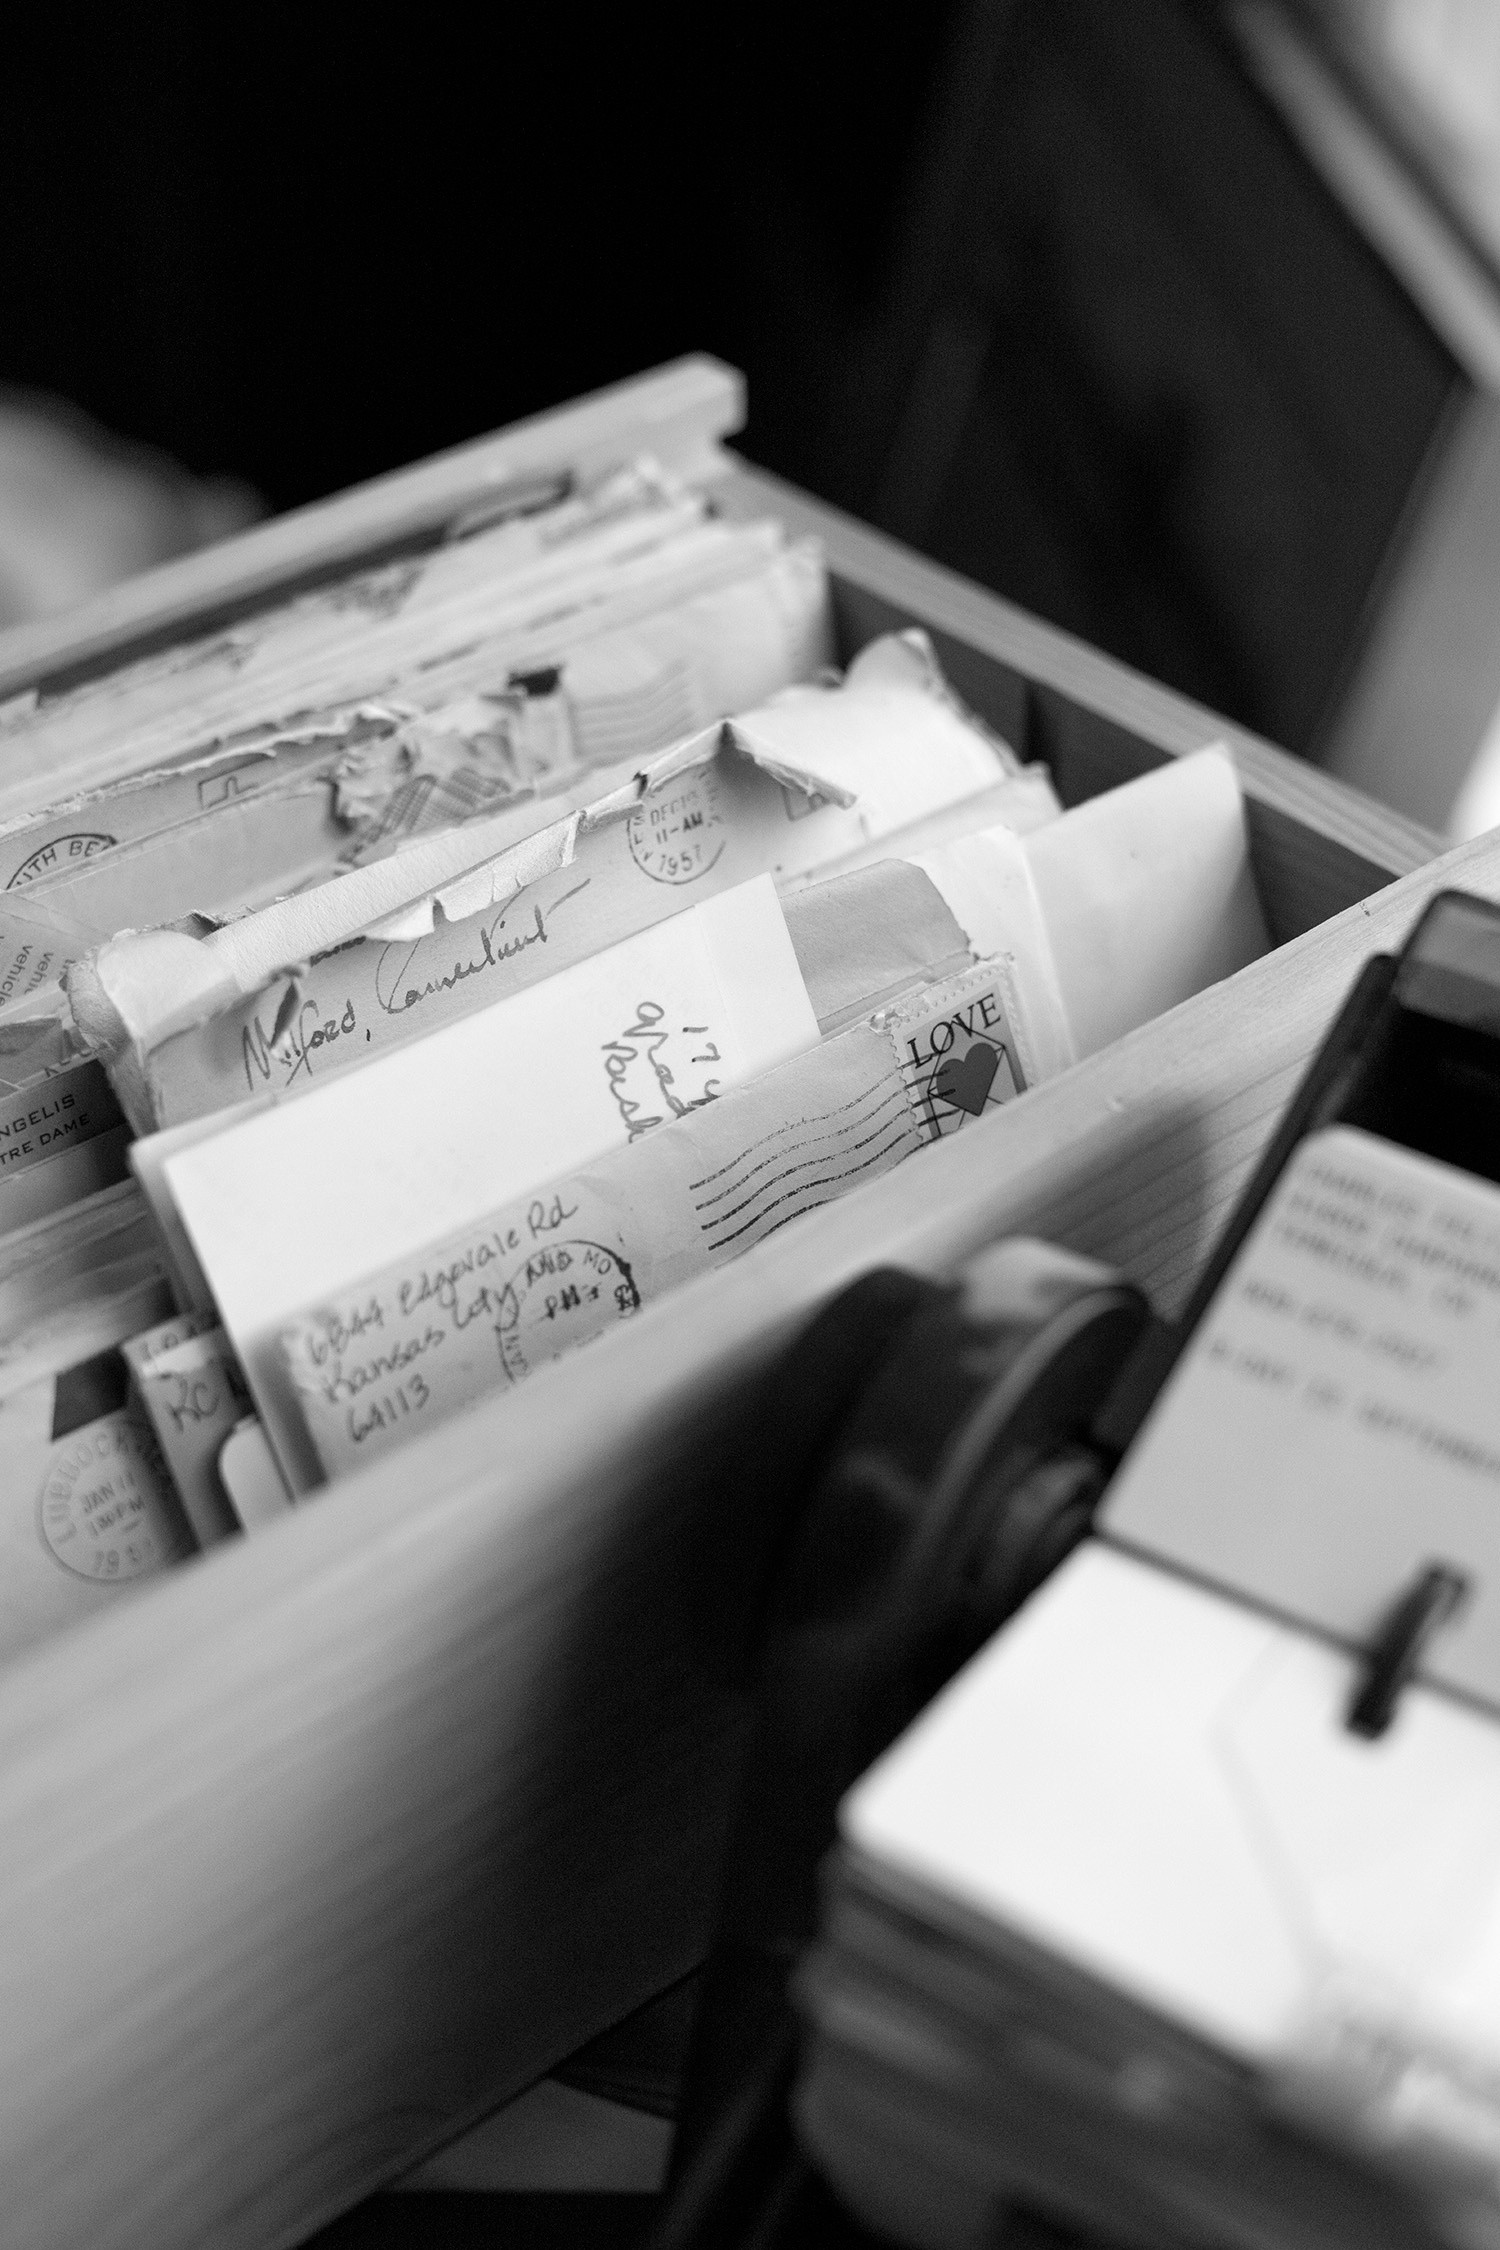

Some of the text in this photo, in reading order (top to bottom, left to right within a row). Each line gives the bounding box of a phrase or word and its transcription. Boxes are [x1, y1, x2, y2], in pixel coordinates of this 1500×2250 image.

[907, 993, 1002, 1070] LOVE
[40, 1113, 91, 1146] DAME
[528, 1195, 579, 1240] Rd
[321, 1327, 446, 1406] Kansas
[346, 1372, 431, 1444] 64113
